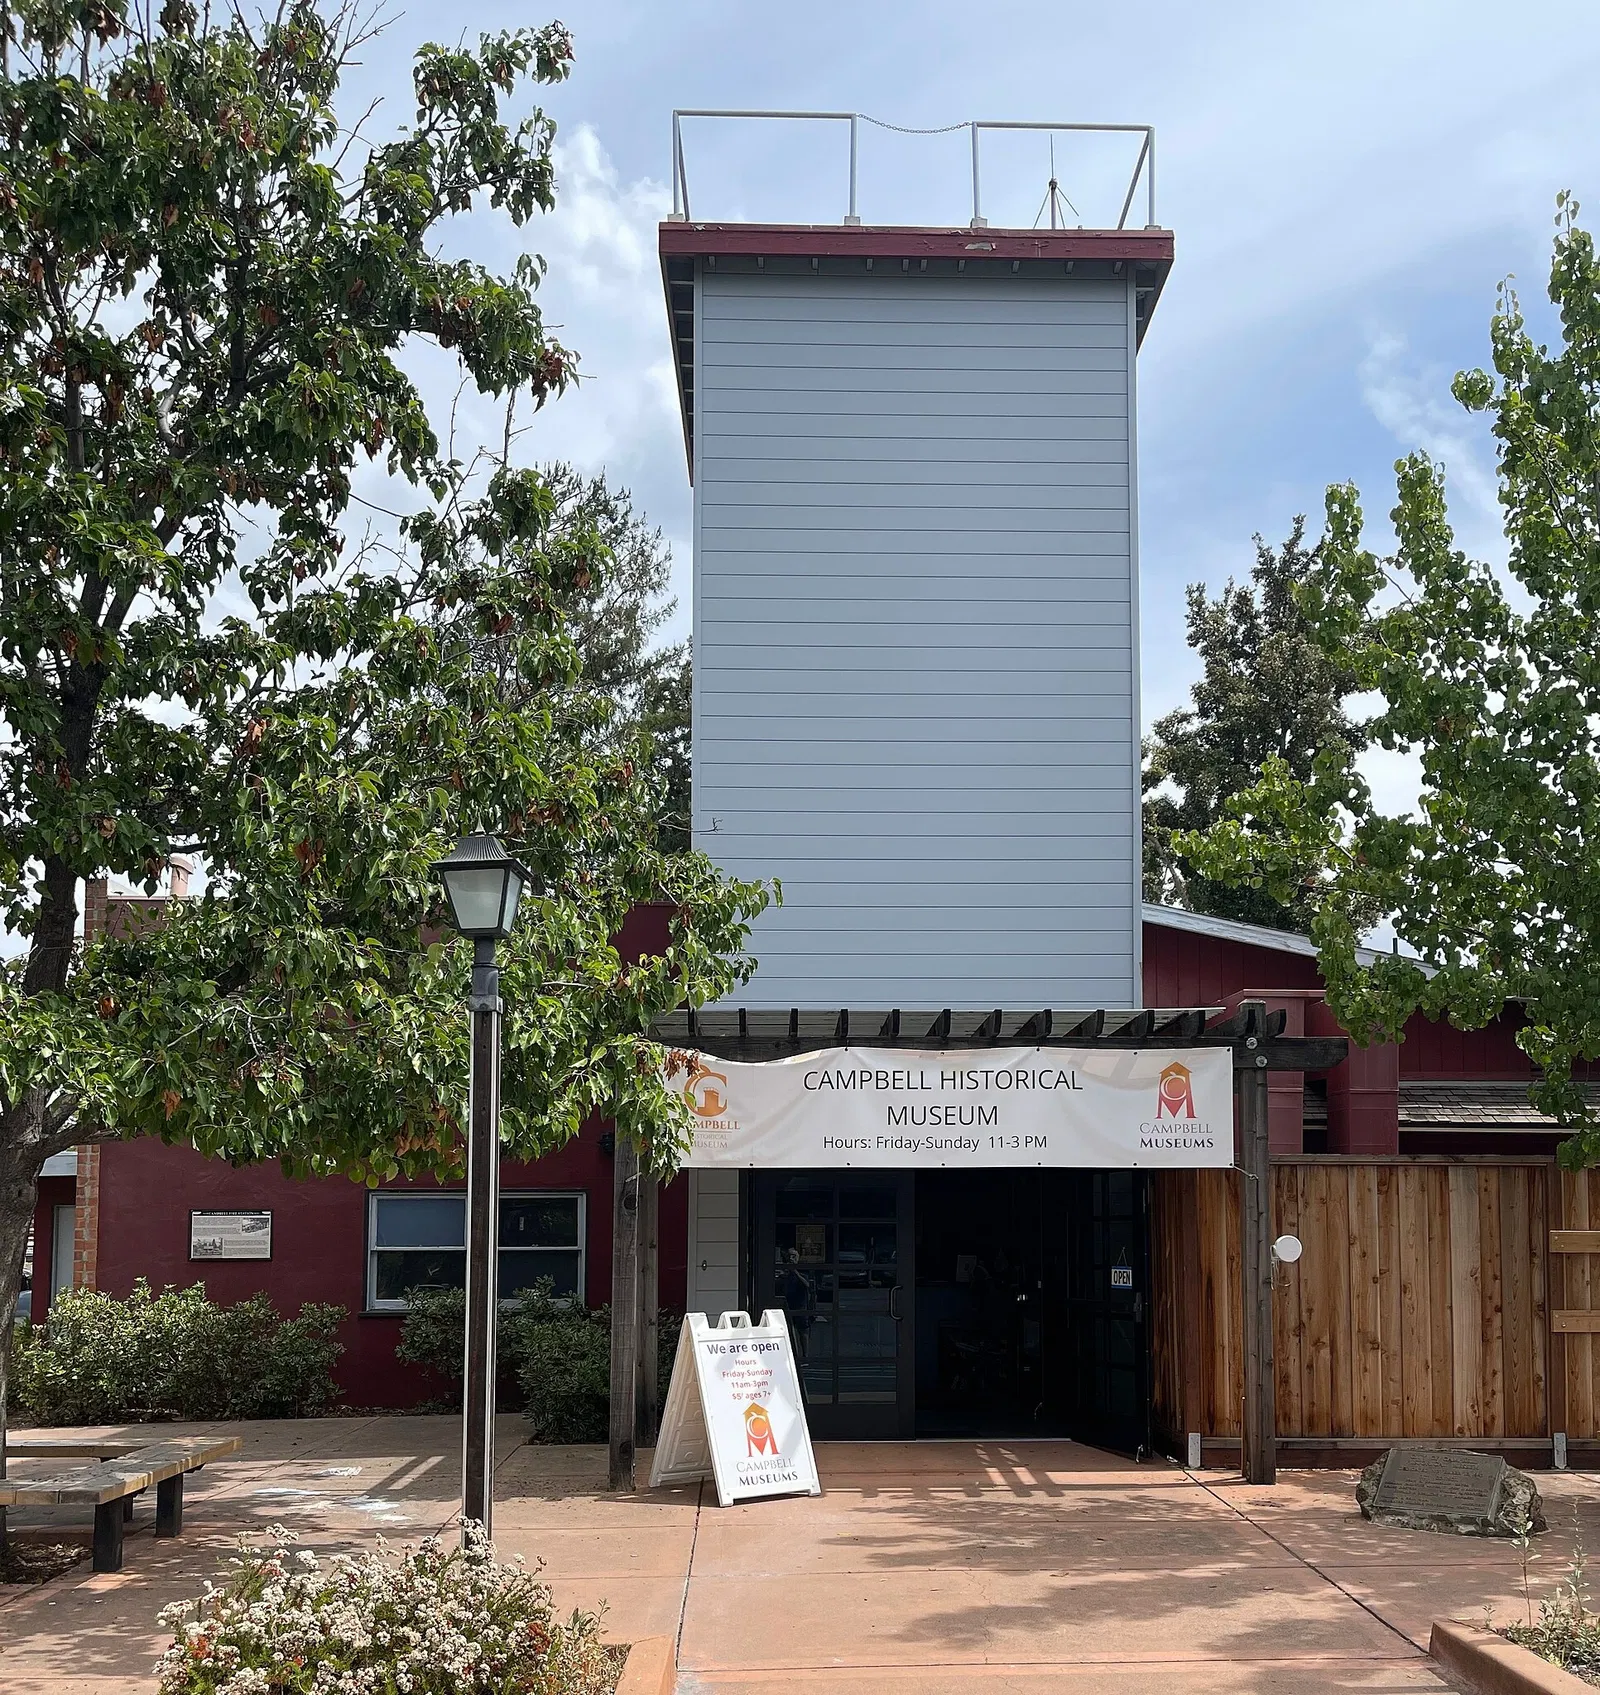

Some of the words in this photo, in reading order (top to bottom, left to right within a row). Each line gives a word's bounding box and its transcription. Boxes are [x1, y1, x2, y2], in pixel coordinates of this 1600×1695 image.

[803, 1070, 932, 1090] CAMPBELL
[940, 1070, 1084, 1091] HISTORICAL
[887, 1105, 999, 1126] MUSEUM
[1139, 1122, 1213, 1134] CAMPBELL
[823, 1136, 872, 1149] Hours:
[876, 1136, 980, 1152] Friday-Sunday
[988, 1136, 1021, 1149] 11-3
[1025, 1136, 1048, 1149] PM
[1139, 1137, 1214, 1149] MUSEUMS
[1113, 1270, 1131, 1285] OPEN
[707, 1344, 726, 1355] We
[729, 1344, 748, 1354] are
[751, 1342, 780, 1355] open
[722, 1368, 773, 1379] Friday-Sunday
[731, 1380, 769, 1389] 11am-3pm
[745, 1392, 762, 1401] ages
[763, 1390, 772, 1398] 7+
[736, 1458, 796, 1473] CAMPBELL
[739, 1470, 798, 1487] MUSEUMS
